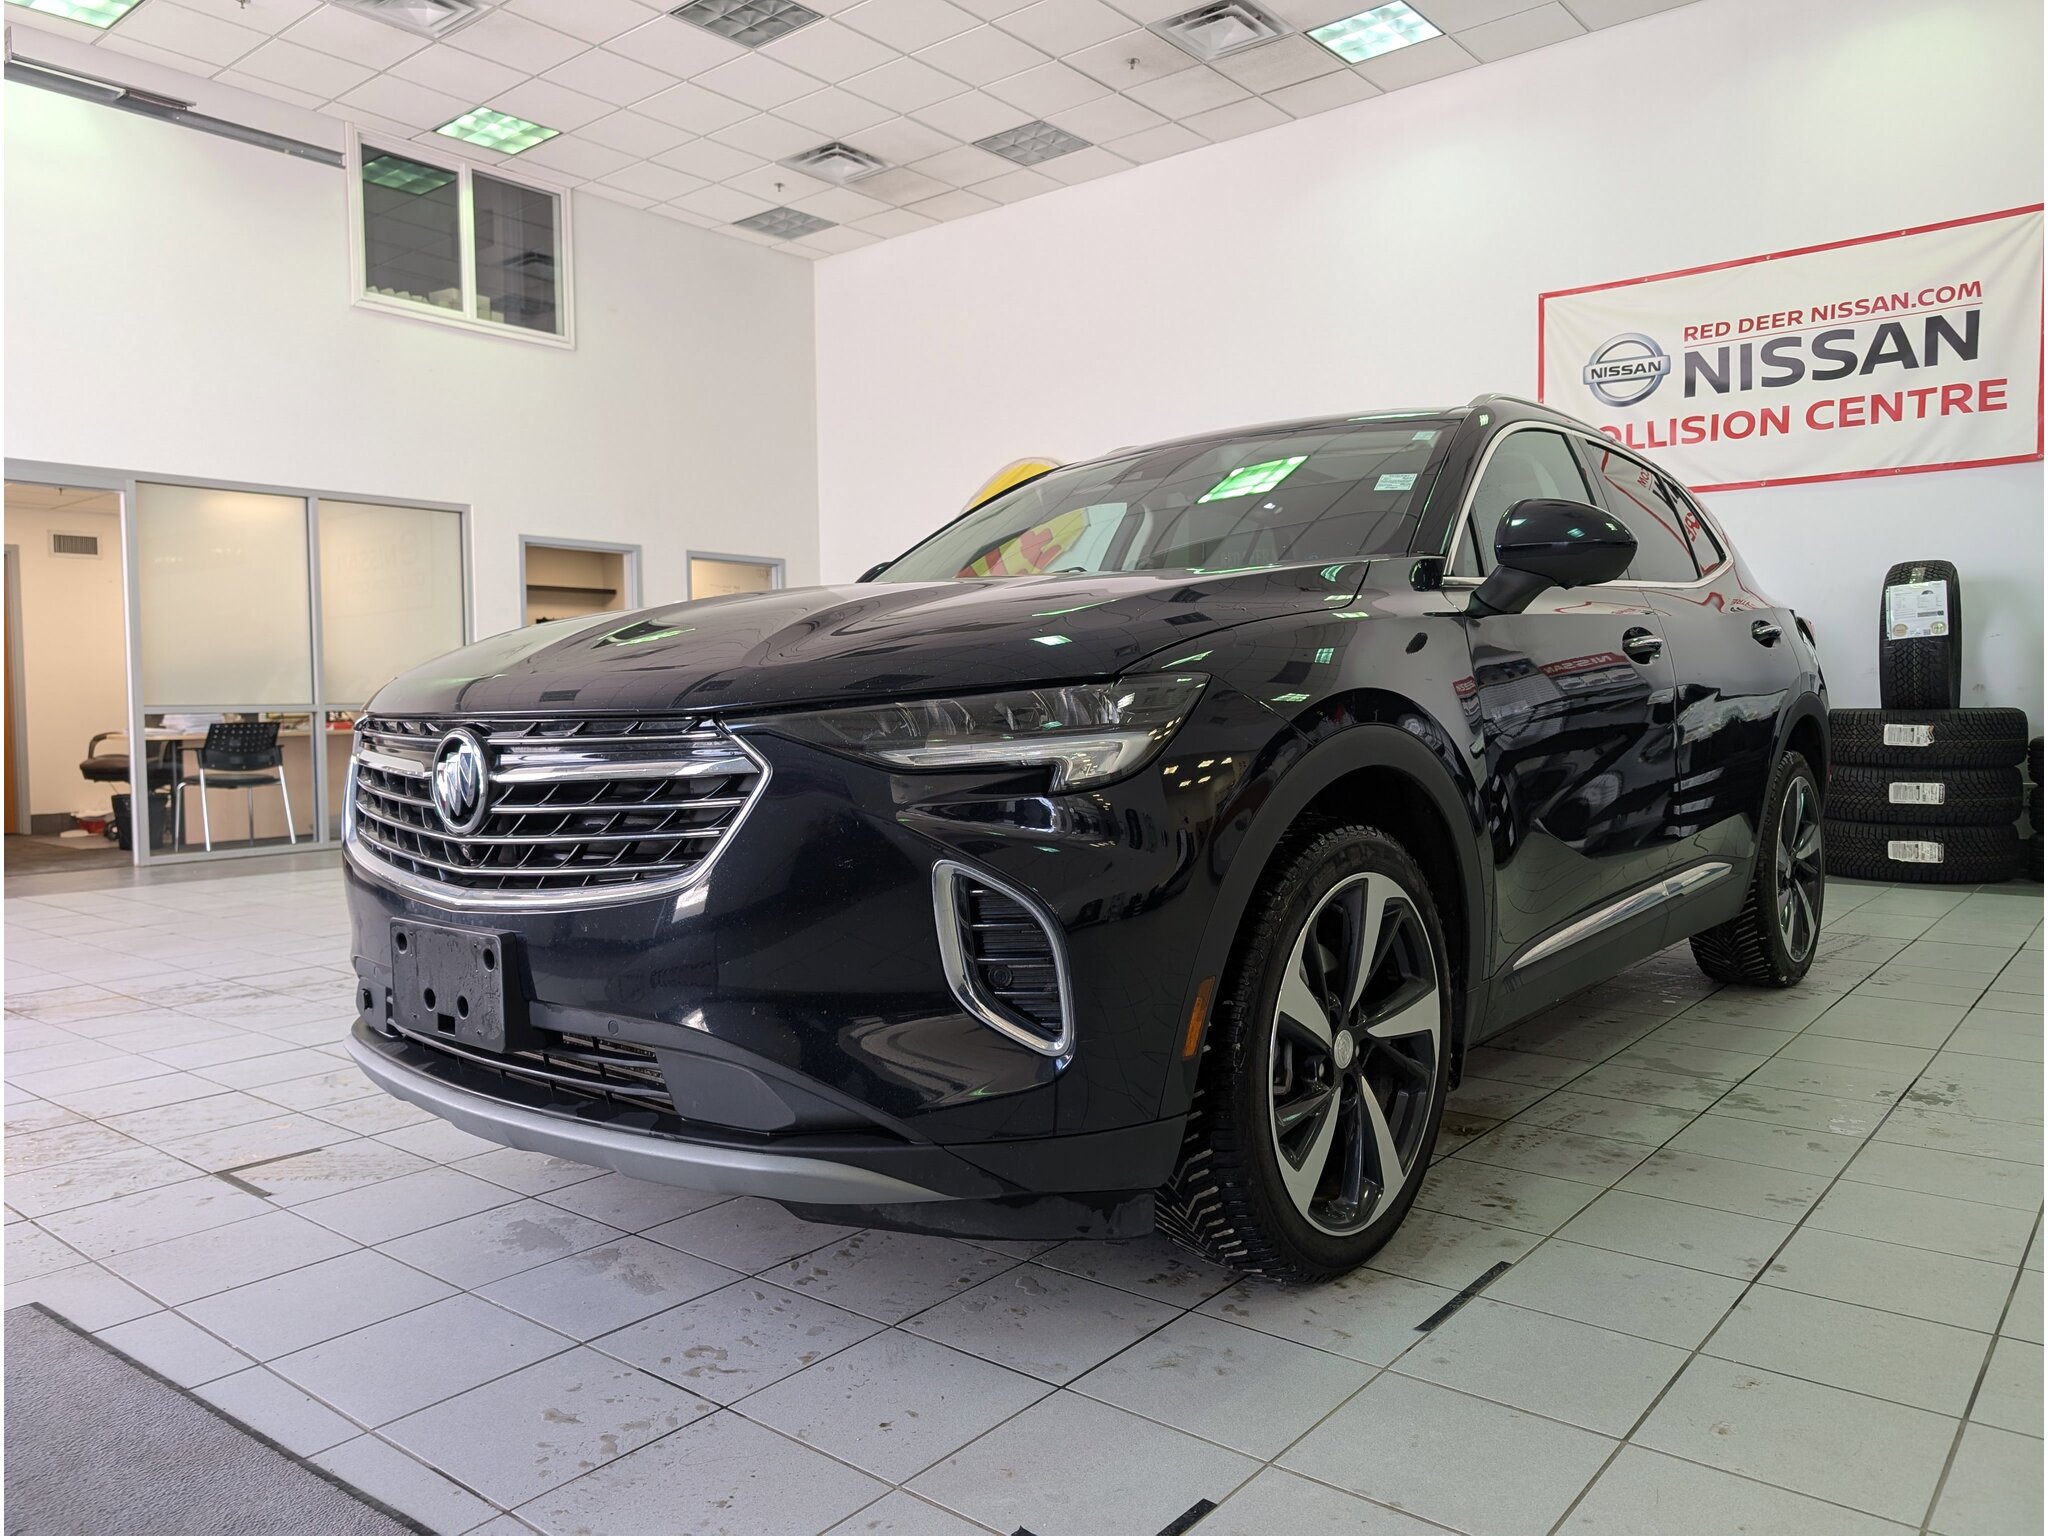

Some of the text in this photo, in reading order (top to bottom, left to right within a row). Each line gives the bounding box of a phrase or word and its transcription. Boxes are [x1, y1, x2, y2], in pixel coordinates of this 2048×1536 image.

[1683, 280, 1983, 341] RED DEER NISSAN.COM
[1591, 360, 1661, 380] NISSAN
[1683, 309, 1981, 398] NISSAN
[1804, 377, 2009, 435] CENTRE
